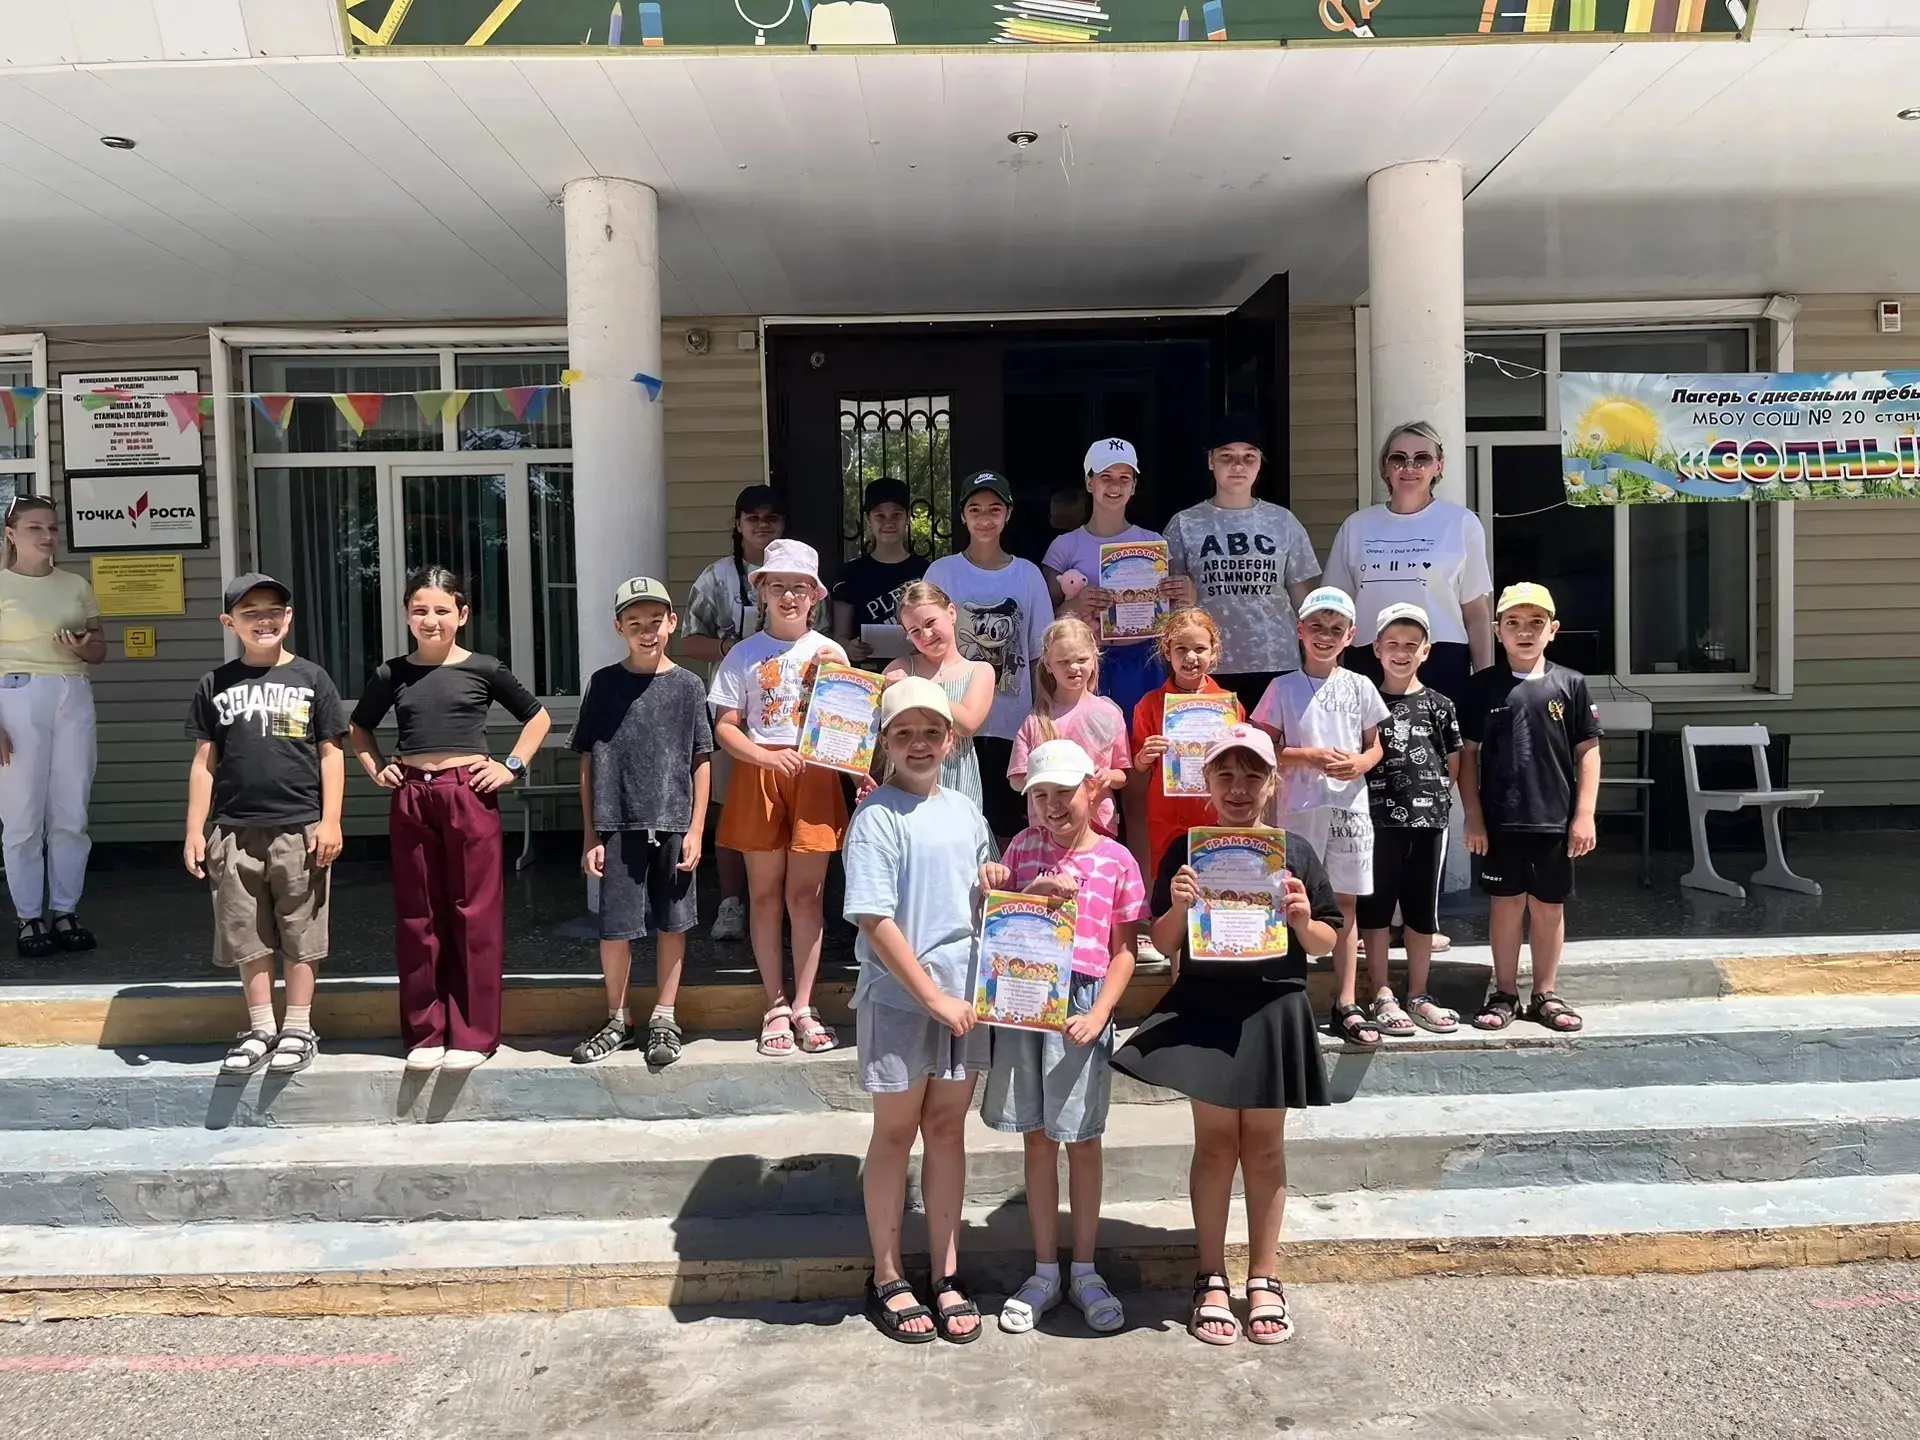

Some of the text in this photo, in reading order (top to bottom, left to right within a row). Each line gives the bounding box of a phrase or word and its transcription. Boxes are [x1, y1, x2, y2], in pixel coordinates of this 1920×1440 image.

[1672, 384, 1920, 406] Лагерь с дневным пребы
[94, 412, 126, 420] СТАНИЦЫ
[1692, 412, 1746, 425] МБОУ
[1752, 412, 1800, 426] СОШ
[1808, 408, 1832, 425] №
[1842, 410, 1865, 424] 20
[1679, 437, 1920, 482] «СОЛНЫ
[76, 508, 195, 520] ТОЧКА РОСТА
[1112, 548, 1156, 560] ГРАМОТА
[1204, 560, 1275, 571] ABCDEFGHI
[1202, 572, 1277, 584] JKLMNOPQR
[1208, 584, 1272, 596] STUVWXYZ
[780, 659, 796, 675] The
[828, 672, 874, 694] ГРАМОТА
[213, 682, 314, 727] CHANGE
[1176, 700, 1224, 712] ГРАМОТА
[1205, 836, 1268, 852] ГРАМОТА
[1000, 902, 1061, 926] ГРАМОТА
